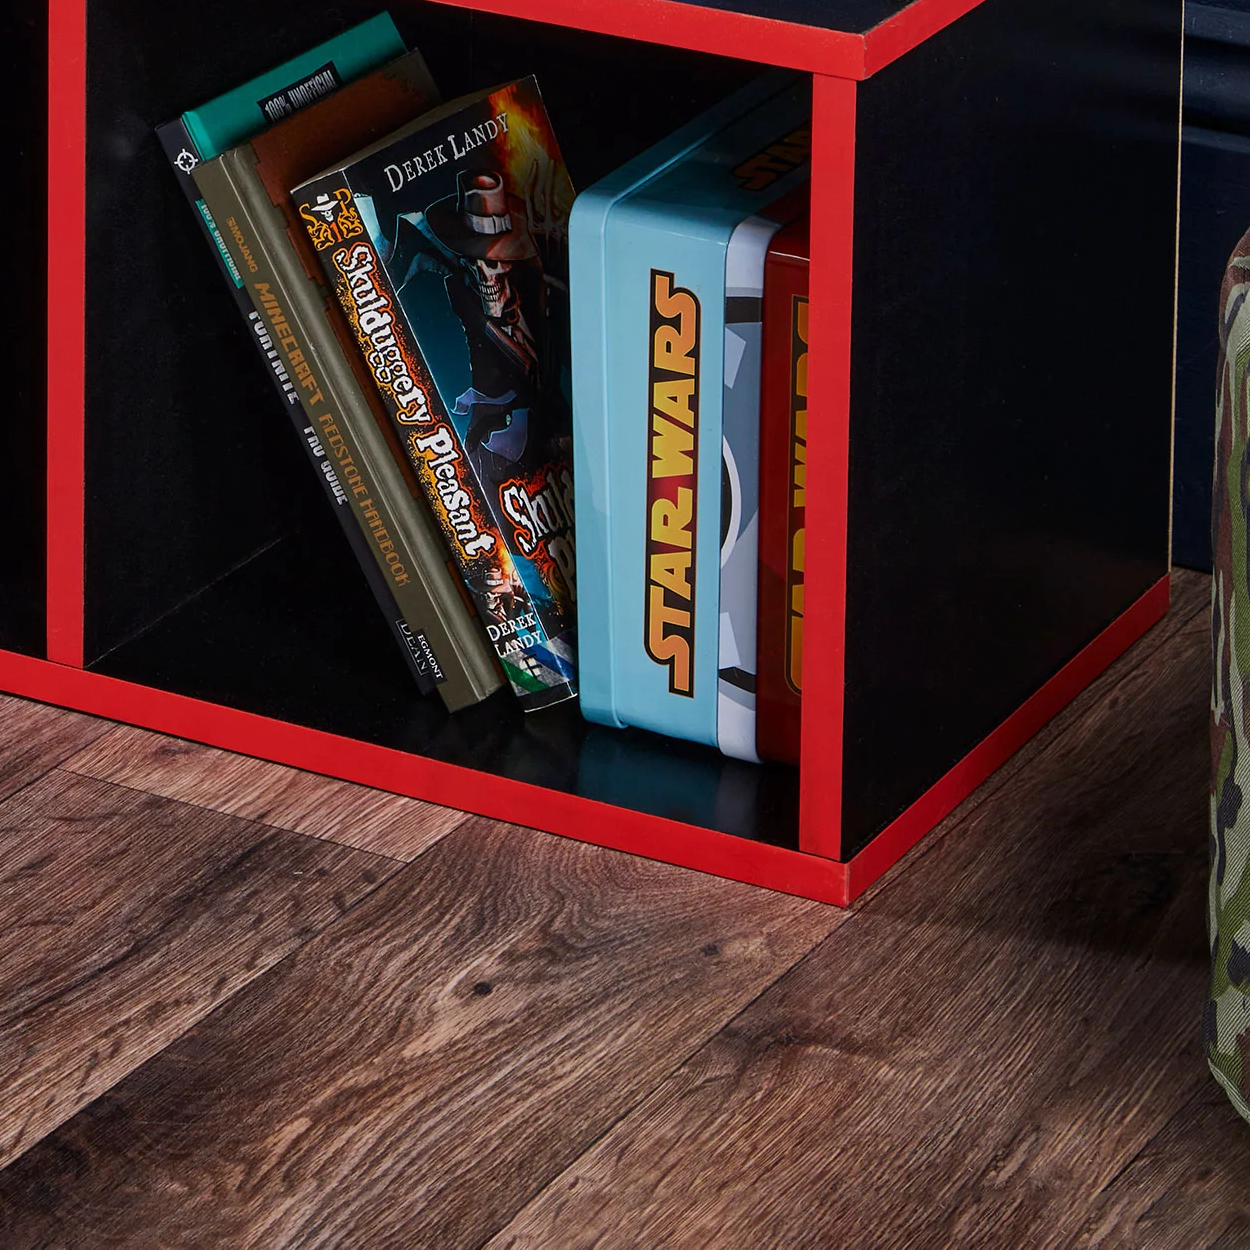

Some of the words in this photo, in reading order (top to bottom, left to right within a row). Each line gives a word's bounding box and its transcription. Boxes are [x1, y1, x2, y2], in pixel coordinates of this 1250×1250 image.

[264, 94, 291, 122] 100%
[287, 69, 338, 108] UNOFFICIAL
[383, 144, 449, 193] DEREK
[447, 112, 510, 160] LANDY
[231, 227, 259, 273] MOJANG
[335, 244, 432, 426] Skulduggery
[416, 424, 496, 558] Pleasant
[651, 272, 699, 479] WARS
[253, 282, 325, 406] MINECRAFT
[317, 413, 369, 499] REDSTONE
[358, 498, 411, 587] HANDBOOK
[647, 486, 693, 694] STAR
[417, 633, 444, 680] EGMONT
[486, 612, 537, 642] DEREK
[494, 630, 544, 658] LANDY
